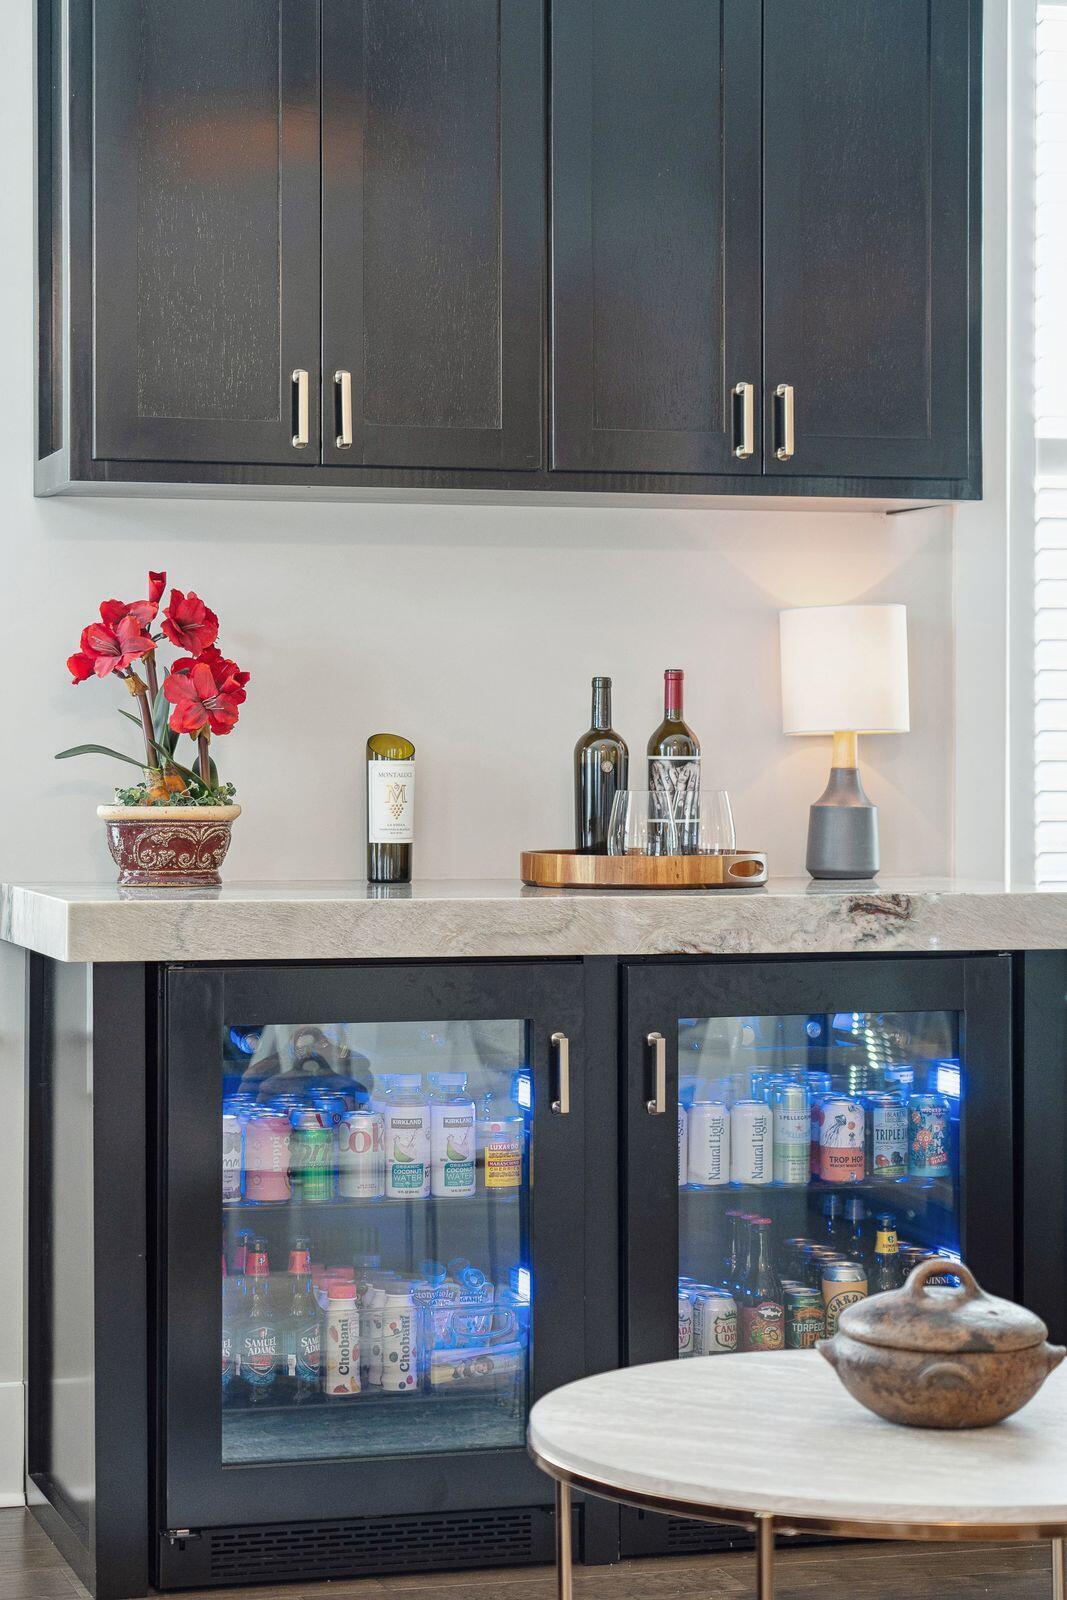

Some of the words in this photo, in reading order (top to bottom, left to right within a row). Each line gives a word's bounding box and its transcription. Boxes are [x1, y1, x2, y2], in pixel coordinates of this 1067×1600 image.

[875, 1129, 901, 1141] TRIPLE
[708, 1145, 721, 1180] Natural
[751, 1144, 764, 1179] Natural
[829, 1155, 850, 1163] TROP
[393, 1173, 422, 1182] WATER
[446, 1172, 473, 1181] WATER
[244, 1336, 277, 1348] SAMUEL
[338, 1319, 350, 1376] Chobani
[399, 1315, 411, 1372] Chobani
[247, 1345, 276, 1356] ADAMS
